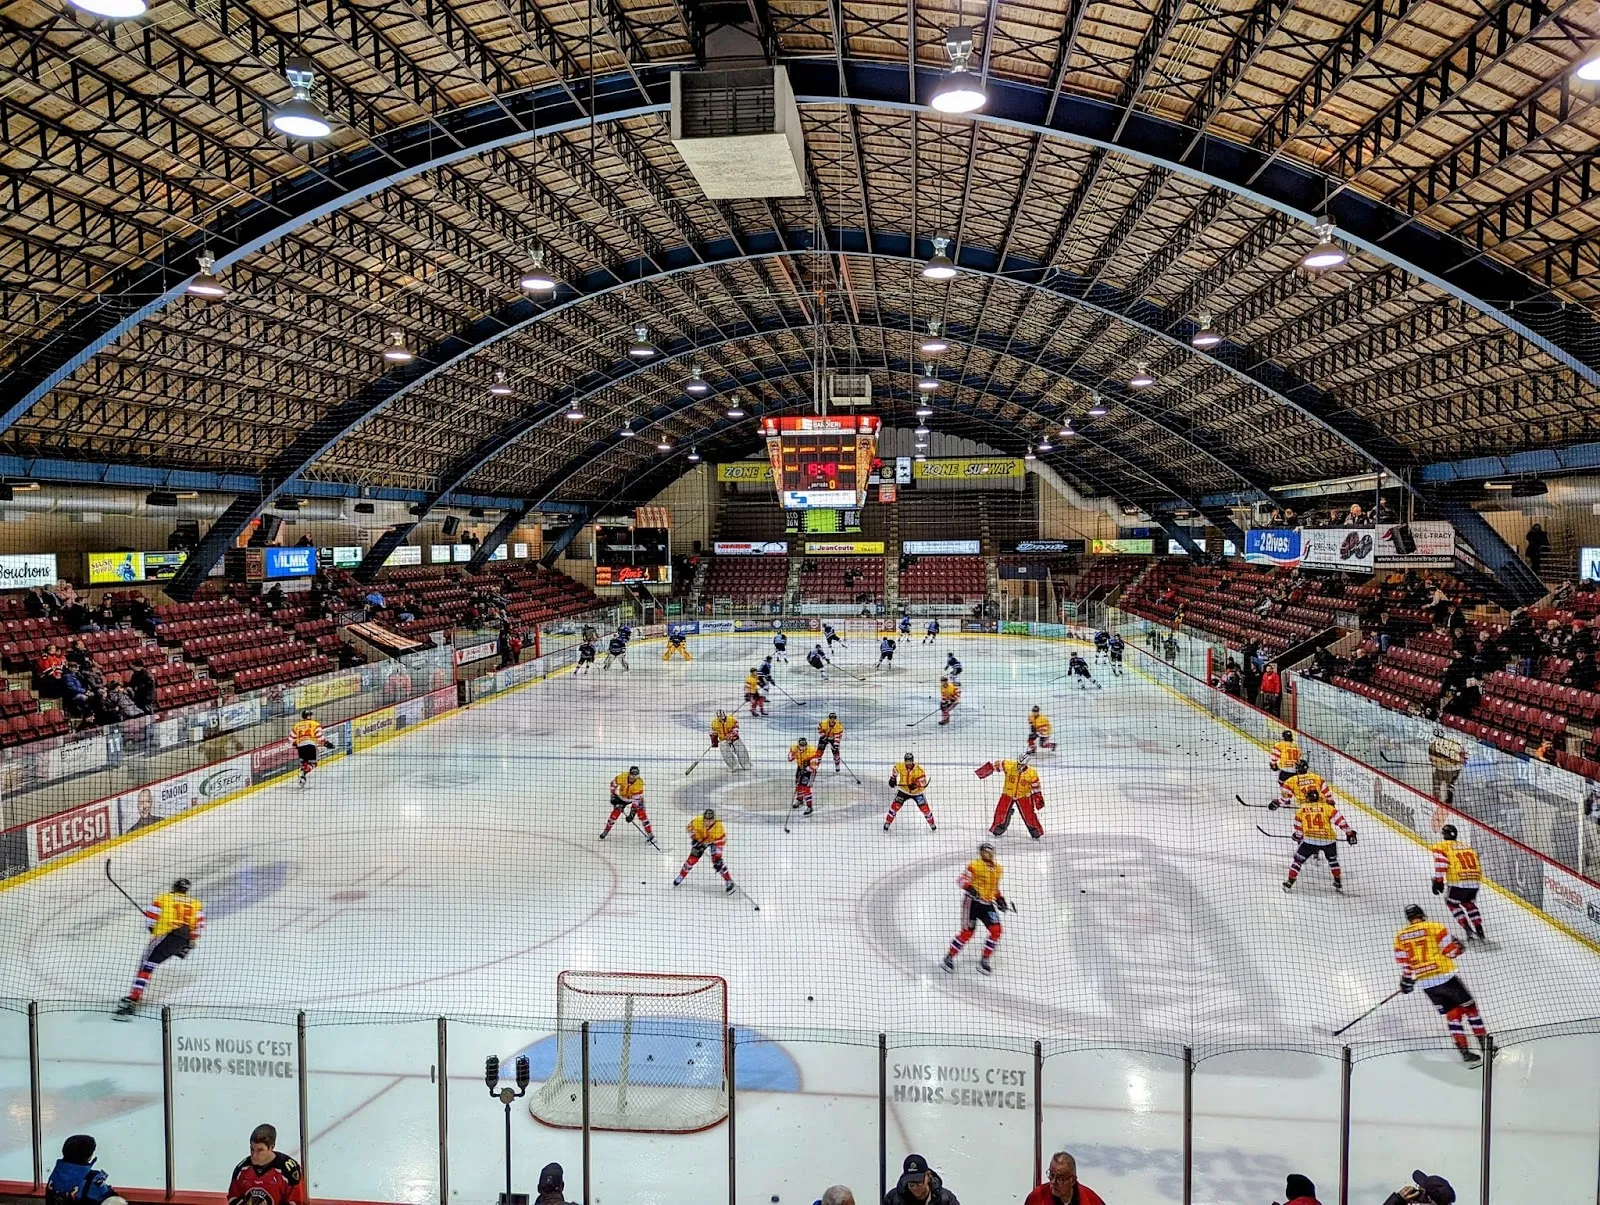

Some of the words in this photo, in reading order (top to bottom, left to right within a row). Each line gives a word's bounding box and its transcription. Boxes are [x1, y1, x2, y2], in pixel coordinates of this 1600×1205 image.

[724, 467, 759, 478] ZONE
[922, 463, 959, 475] ZONE
[273, 553, 309, 568] VILMIK
[619, 567, 643, 582] Jim's
[1305, 813, 1325, 830] 14
[41, 811, 107, 858] ELECSO
[1455, 851, 1477, 870] 10
[177, 1036, 211, 1052] SANS
[215, 1038, 253, 1055] NOUS
[257, 1040, 293, 1057] C'EST
[177, 1056, 222, 1074] HORS
[227, 1059, 294, 1079] SERVICE
[893, 1063, 932, 1080] SANS
[937, 1065, 980, 1083] NOUS
[985, 1068, 1026, 1086] C'EST
[893, 1084, 944, 1104] HORS
[950, 1087, 1026, 1110] SERVICE
